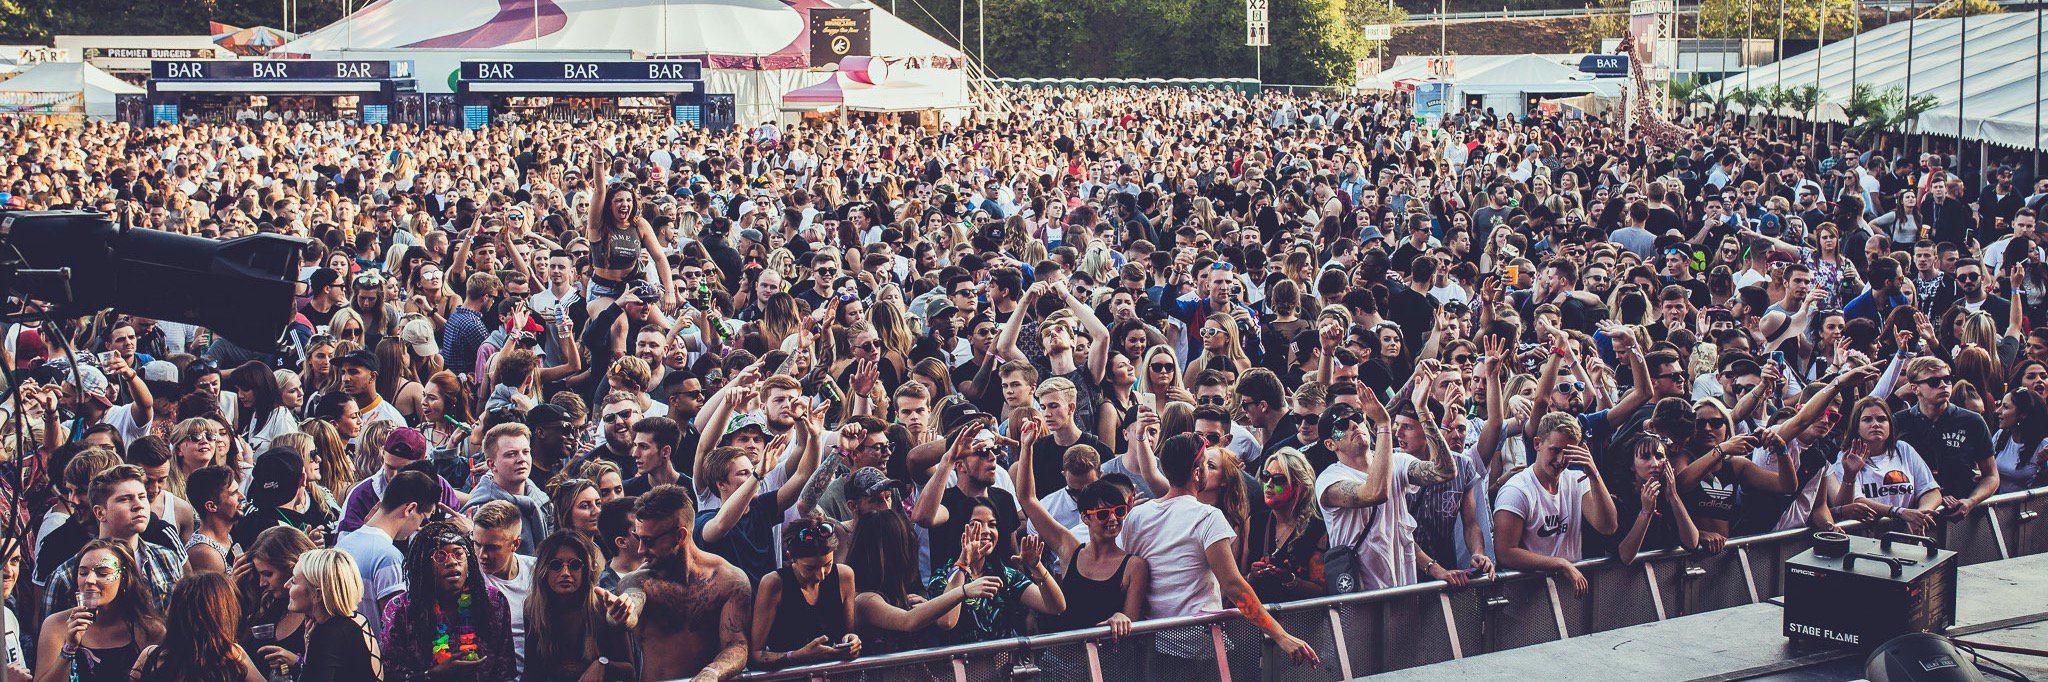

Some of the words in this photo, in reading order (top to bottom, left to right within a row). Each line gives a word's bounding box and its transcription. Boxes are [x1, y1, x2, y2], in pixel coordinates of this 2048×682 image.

[108, 49, 148, 58] PREMIER
[151, 49, 191, 58] BURGERS
[168, 62, 203, 78] BAR
[252, 62, 287, 78] BAR
[337, 62, 372, 78] BAR
[1596, 59, 1618, 68] BAR
[479, 64, 514, 79] BAR
[564, 64, 600, 79] BAR
[649, 64, 683, 79] BAR
[1942, 432, 1966, 443] JAPAN
[1544, 514, 1561, 527] NIK
[1789, 622, 1821, 637] STAGE
[1824, 629, 1859, 644] FLAME
